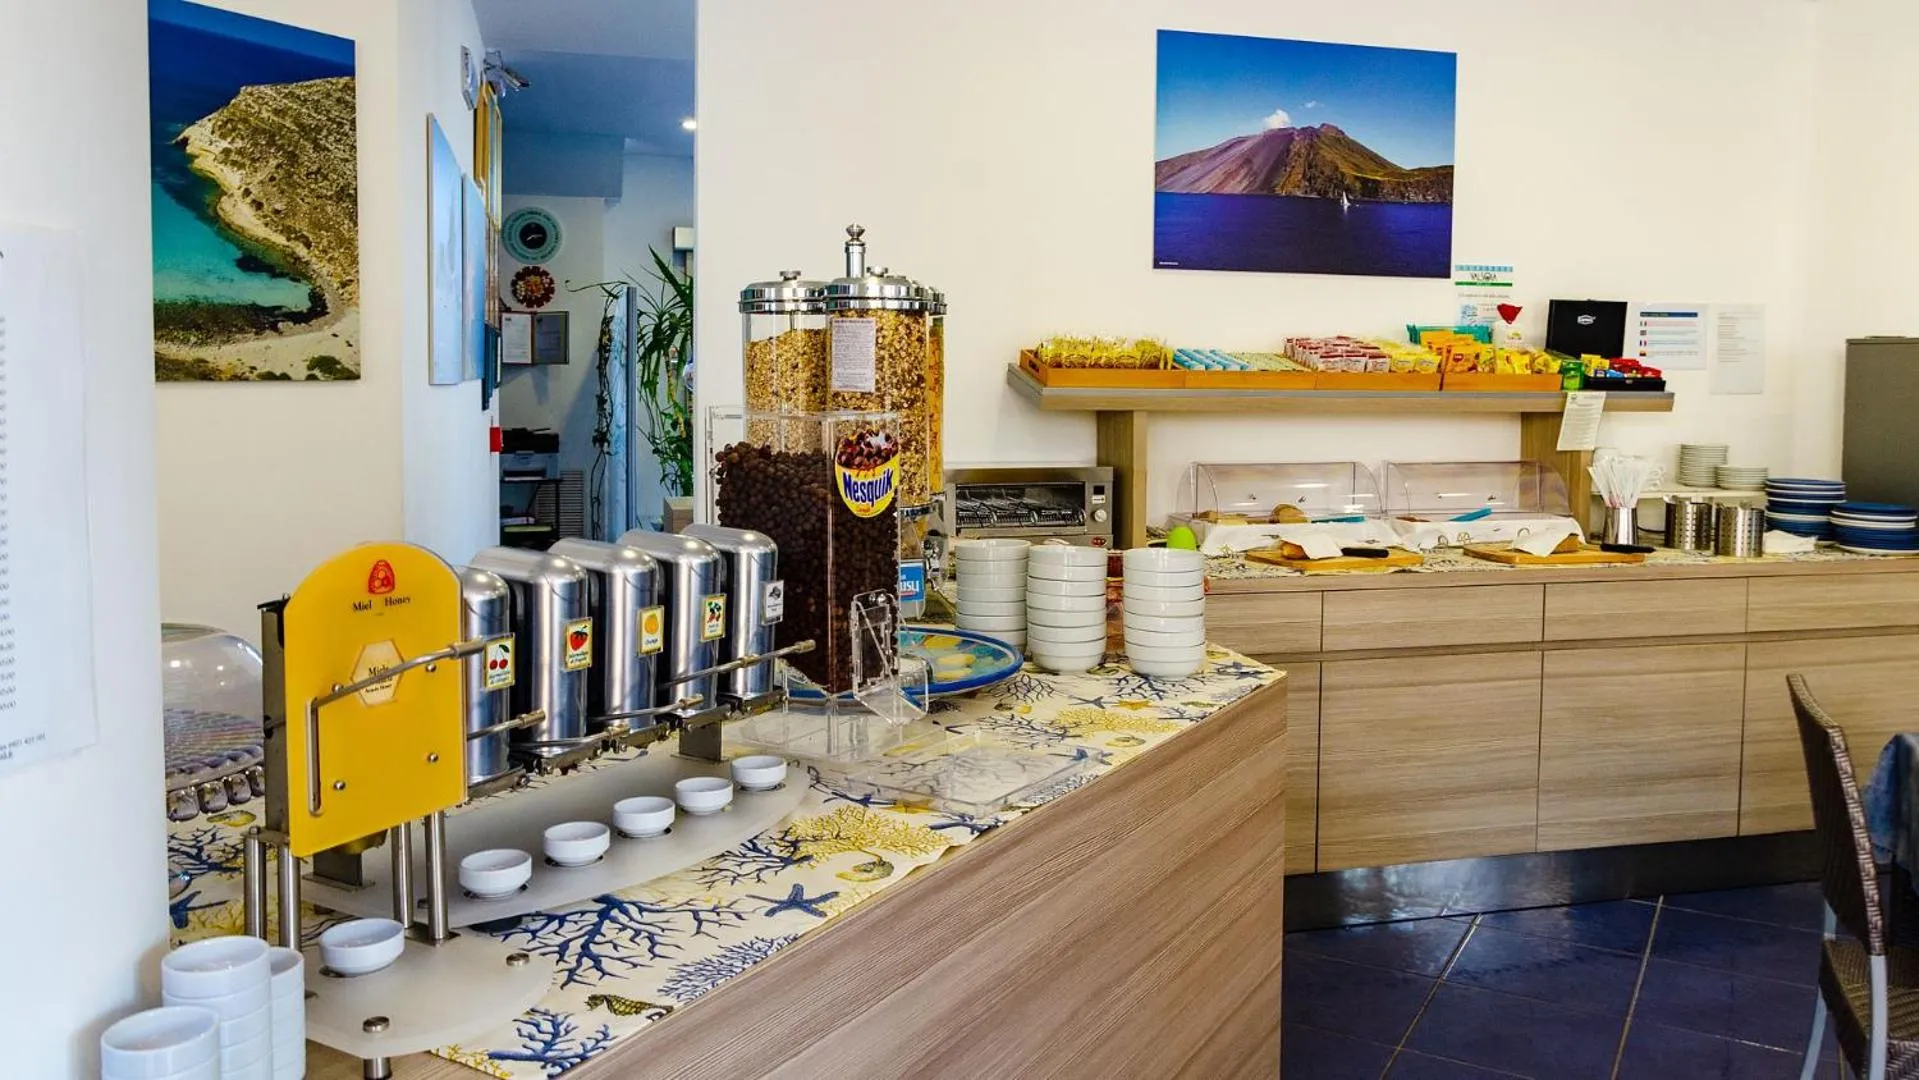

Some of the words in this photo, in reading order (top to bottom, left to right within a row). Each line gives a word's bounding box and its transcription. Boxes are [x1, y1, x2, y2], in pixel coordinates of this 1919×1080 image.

[842, 467, 894, 509] Nesquik
[900, 580, 920, 593] USLI
[353, 600, 372, 612] Miel
[384, 597, 411, 607] Honey
